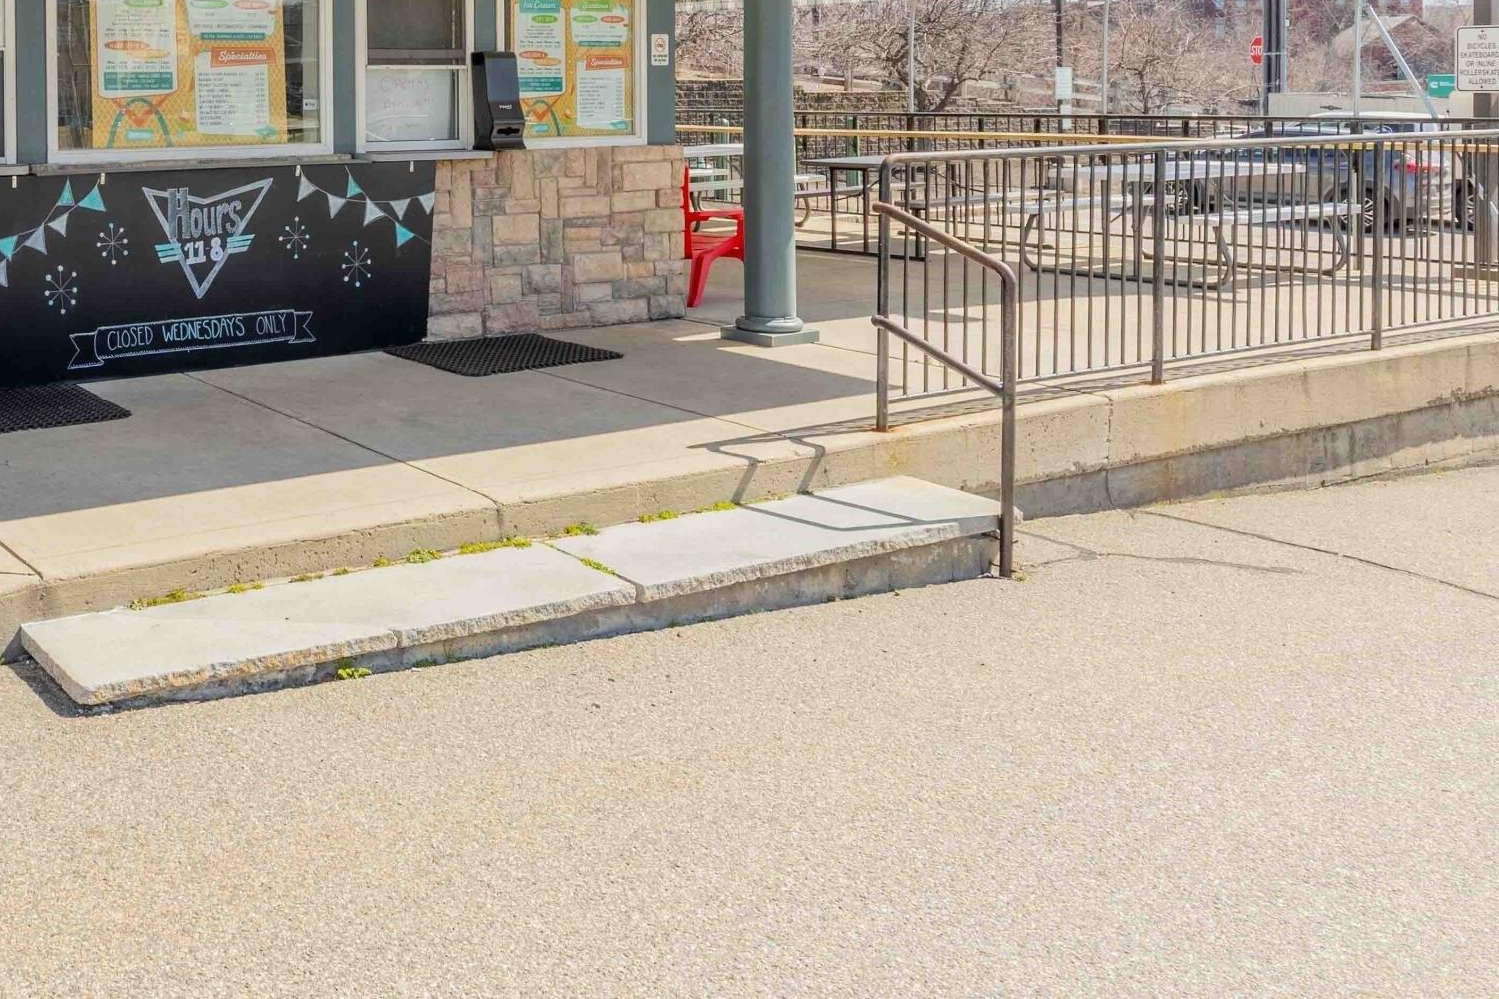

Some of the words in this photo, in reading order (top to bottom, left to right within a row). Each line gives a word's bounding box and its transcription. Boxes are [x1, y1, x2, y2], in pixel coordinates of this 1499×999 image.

[218, 49, 267, 62] Specialties
[167, 187, 242, 241] Hours
[184, 236, 225, 265] 11-8
[107, 325, 154, 351] CLOSED
[162, 315, 245, 342] WEDNESDAYS
[255, 312, 288, 335] ONLY
